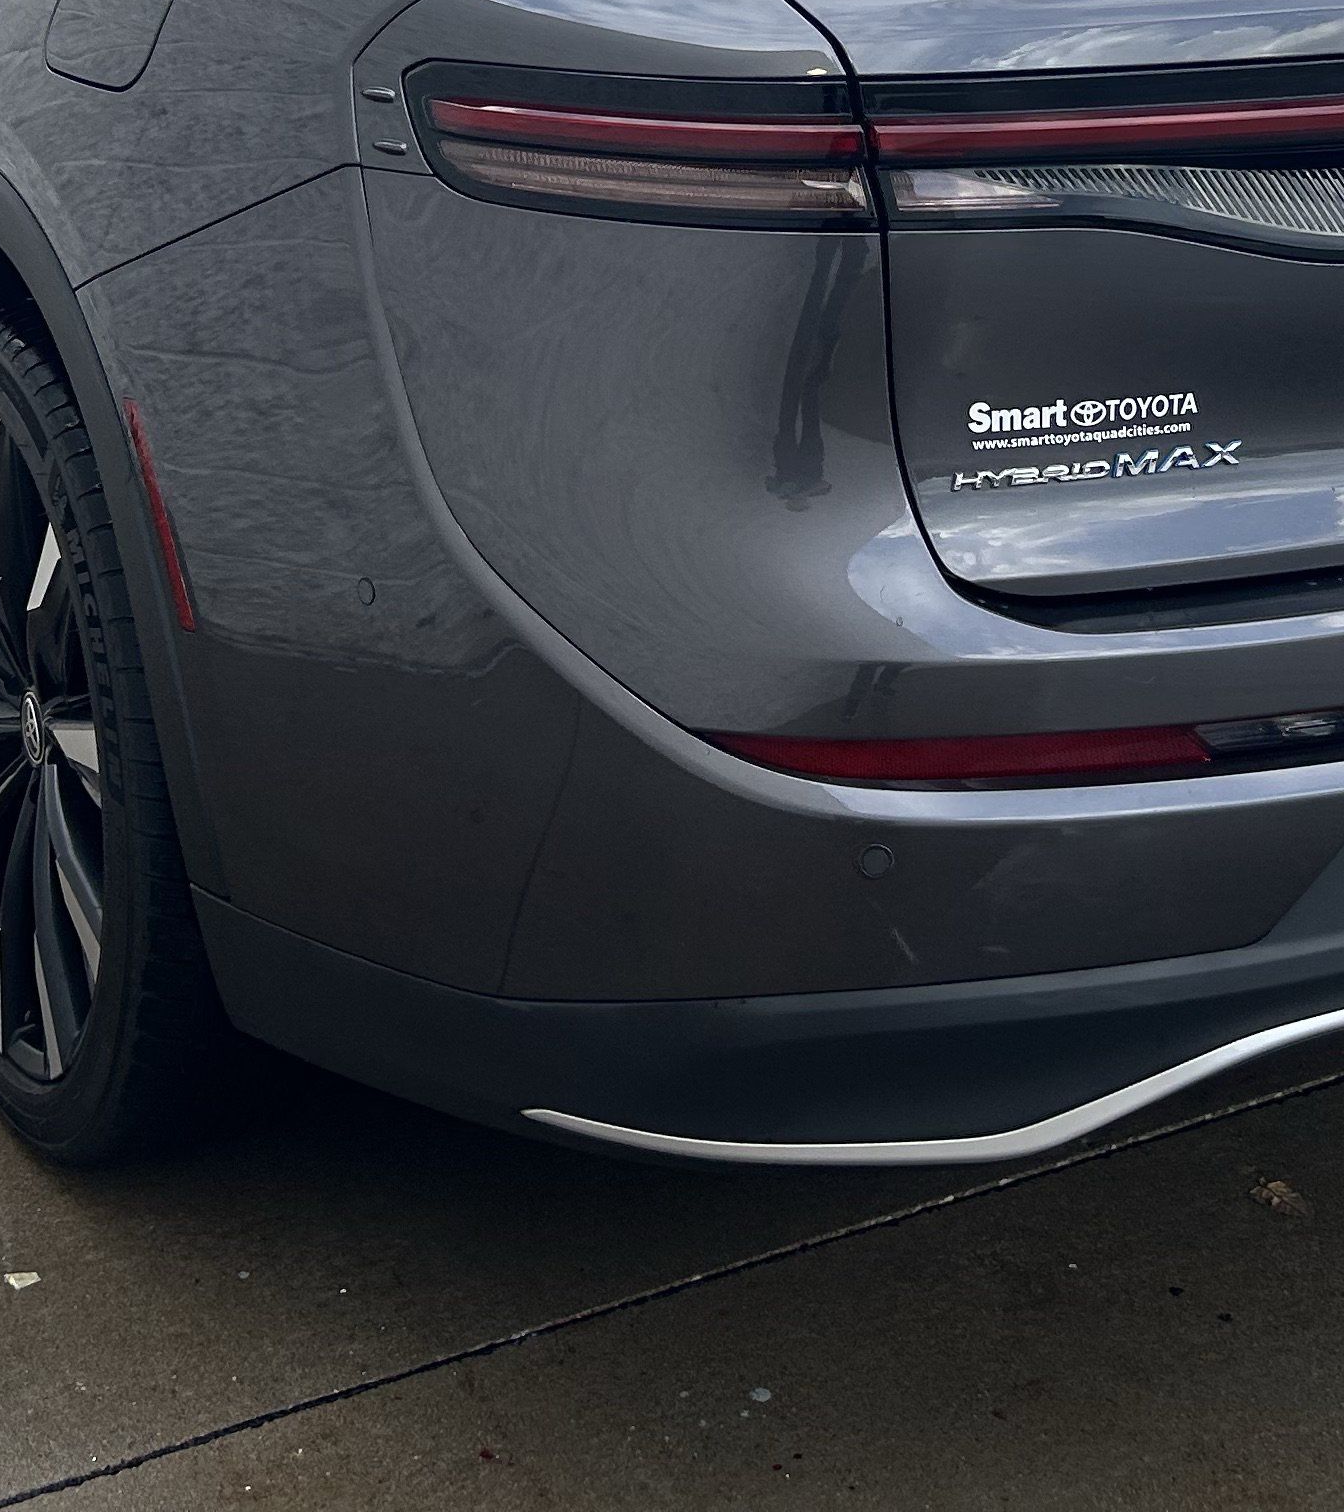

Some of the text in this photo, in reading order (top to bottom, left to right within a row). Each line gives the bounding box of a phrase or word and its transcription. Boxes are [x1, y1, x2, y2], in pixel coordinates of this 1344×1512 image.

[967, 392, 1198, 433] Smart TOYOTA
[972, 422, 1191, 450] www.smarttoyotaquadcities.com
